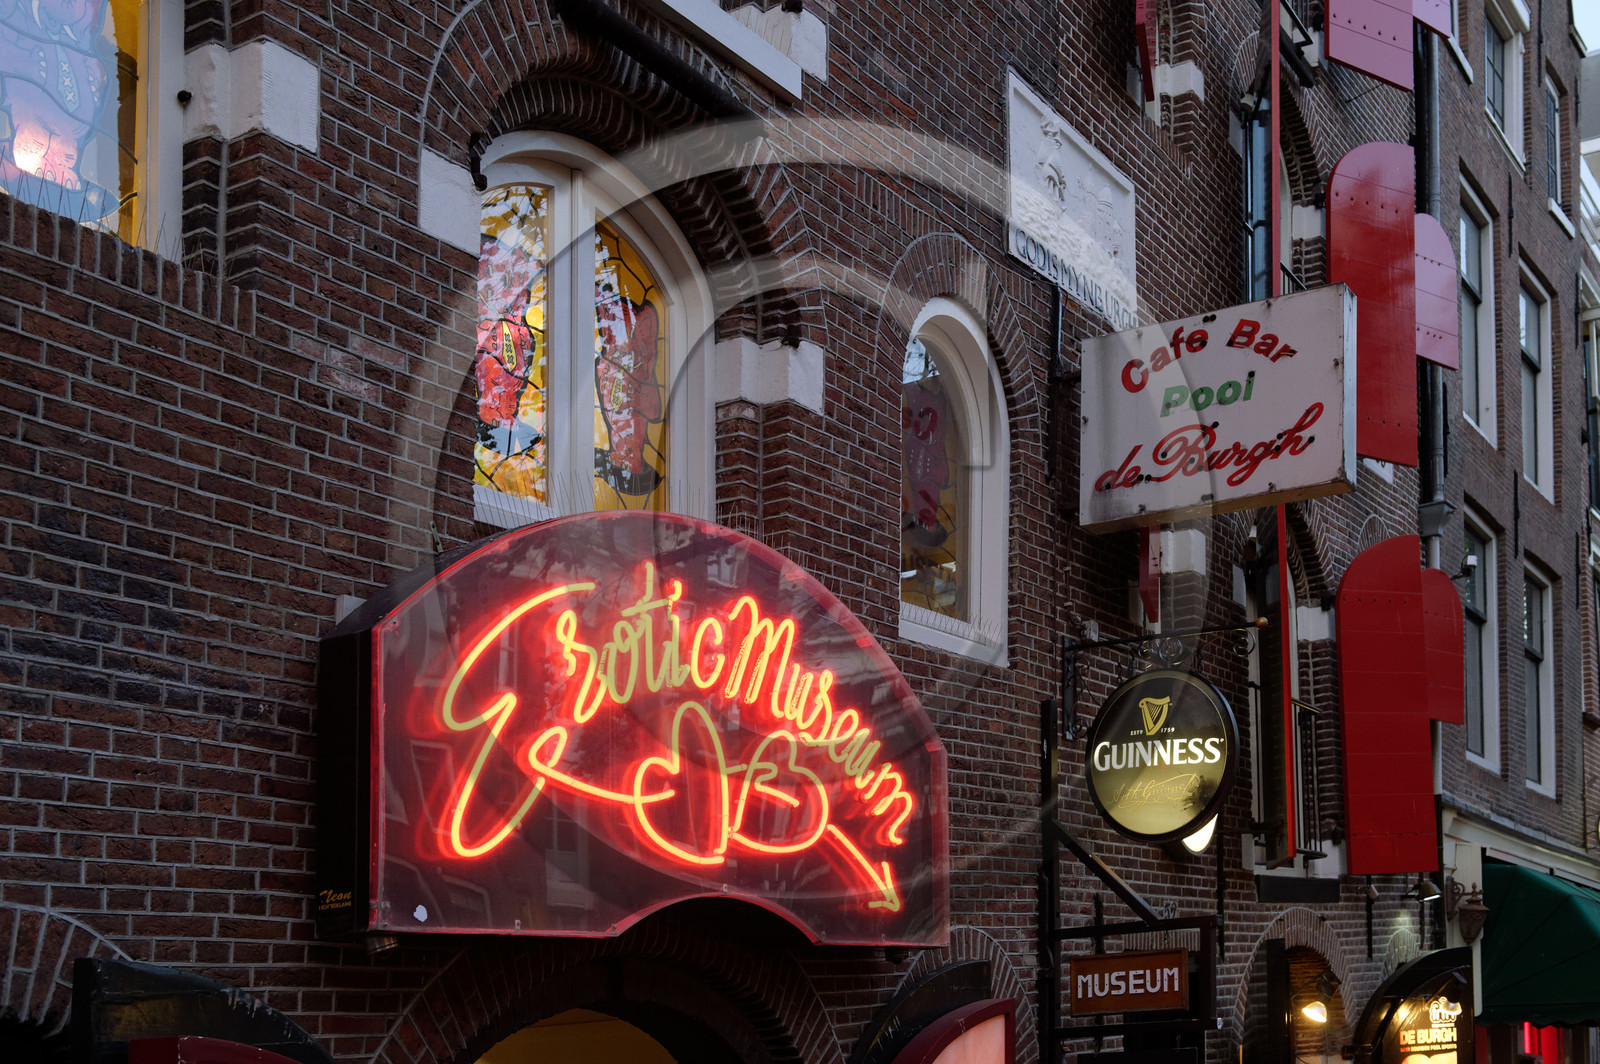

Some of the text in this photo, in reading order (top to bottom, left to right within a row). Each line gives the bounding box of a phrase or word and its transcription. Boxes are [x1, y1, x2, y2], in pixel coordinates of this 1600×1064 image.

[1121, 318, 1298, 394] Cafe Bar
[1160, 370, 1257, 419] Pool
[1094, 402, 1324, 493] de Burgh
[442, 560, 918, 858] Erotic Museum
[1160, 726, 1176, 734] 1759
[1093, 737, 1221, 772] GUINNESS
[1077, 967, 1179, 999] MUSEUM
[1400, 1027, 1457, 1045] DE BURGH
